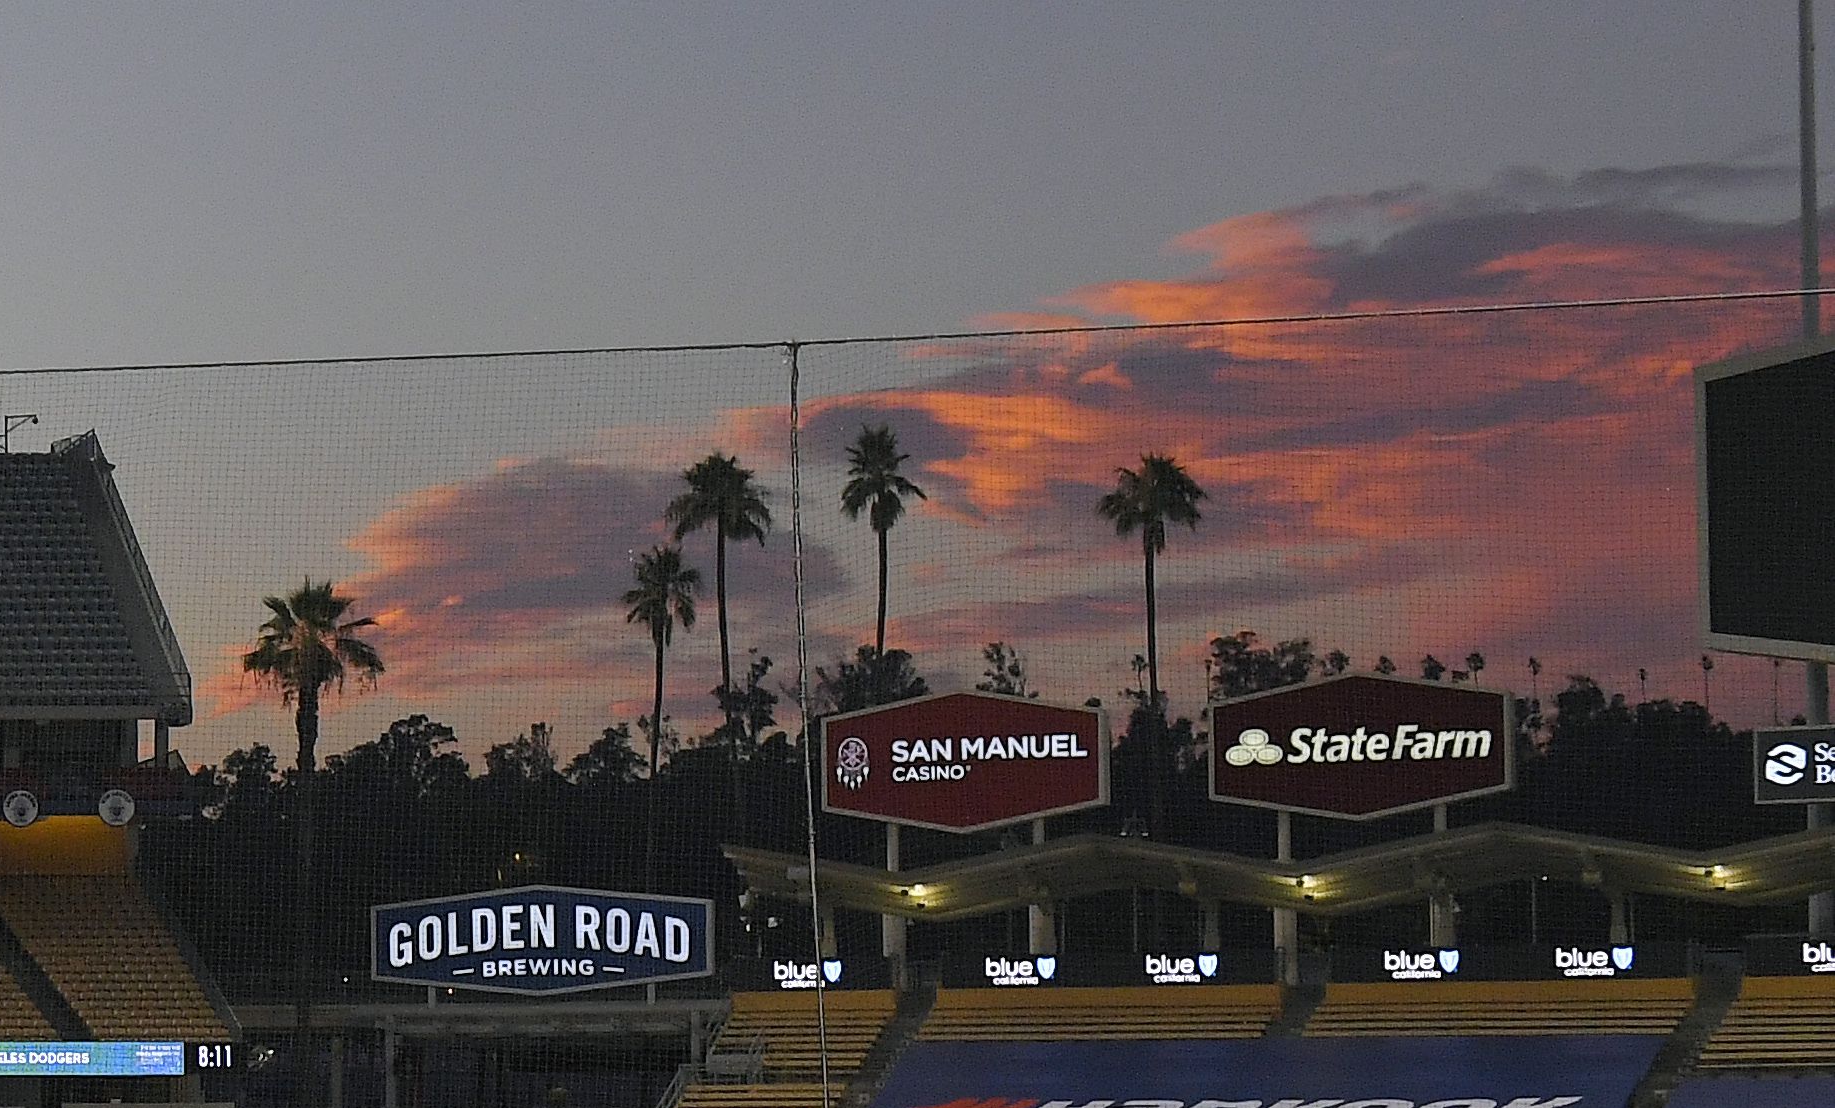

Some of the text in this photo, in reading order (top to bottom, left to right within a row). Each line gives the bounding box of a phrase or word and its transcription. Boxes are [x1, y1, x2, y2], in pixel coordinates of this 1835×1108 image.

[891, 734, 1088, 763] SAN MANUEL
[892, 764, 965, 782] CASINO
[388, 904, 690, 968] GOLDEN ROAD
[985, 957, 1033, 976] blue
[1145, 954, 1194, 974] blue
[1384, 950, 1435, 970] blue
[1555, 948, 1608, 967] blue
[482, 958, 595, 978] BREWING
[774, 961, 817, 980] blue
[29, 1052, 90, 1065] DODGERS
[198, 1045, 231, 1068] 8:11
